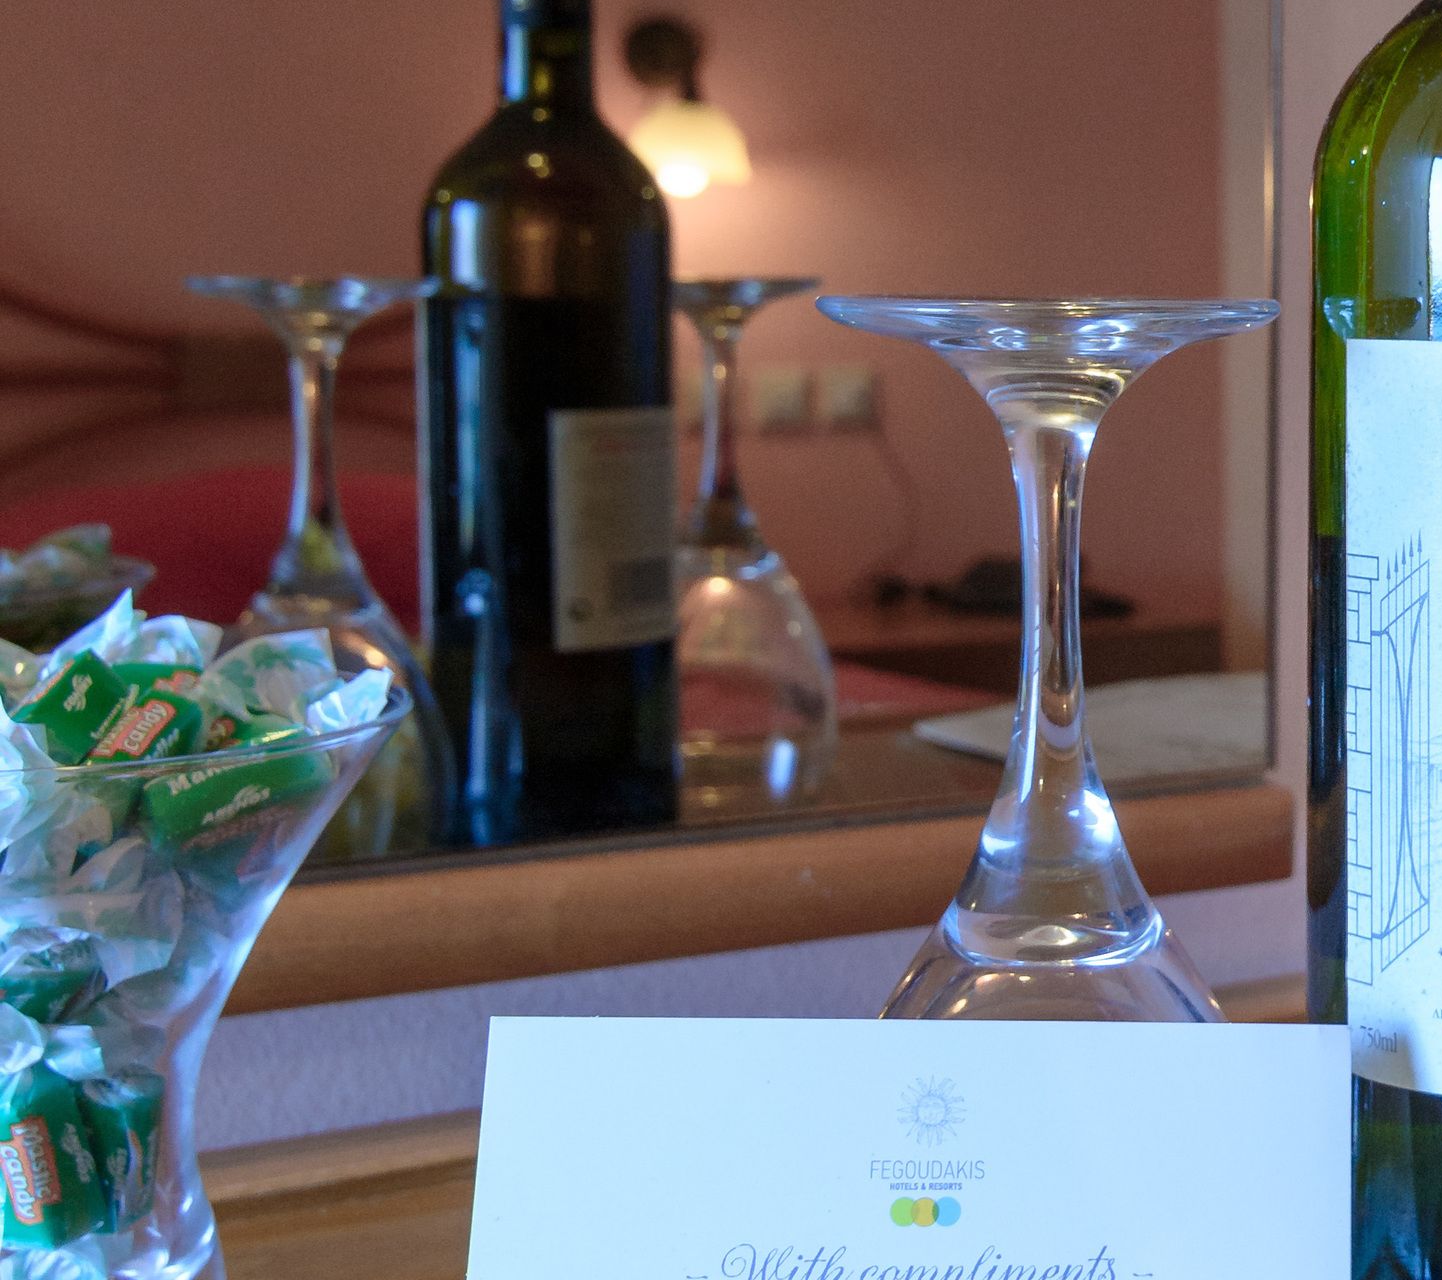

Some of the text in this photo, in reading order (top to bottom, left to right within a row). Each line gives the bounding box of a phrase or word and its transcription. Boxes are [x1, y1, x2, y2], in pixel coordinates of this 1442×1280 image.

[124, 702, 169, 753] candy
[1360, 1024, 1398, 1053] 750ml
[0, 1144, 36, 1219] candy
[869, 1159, 986, 1180] FEGOUDAKIS
[889, 1182, 963, 1191] HOTELS & RESORTS
